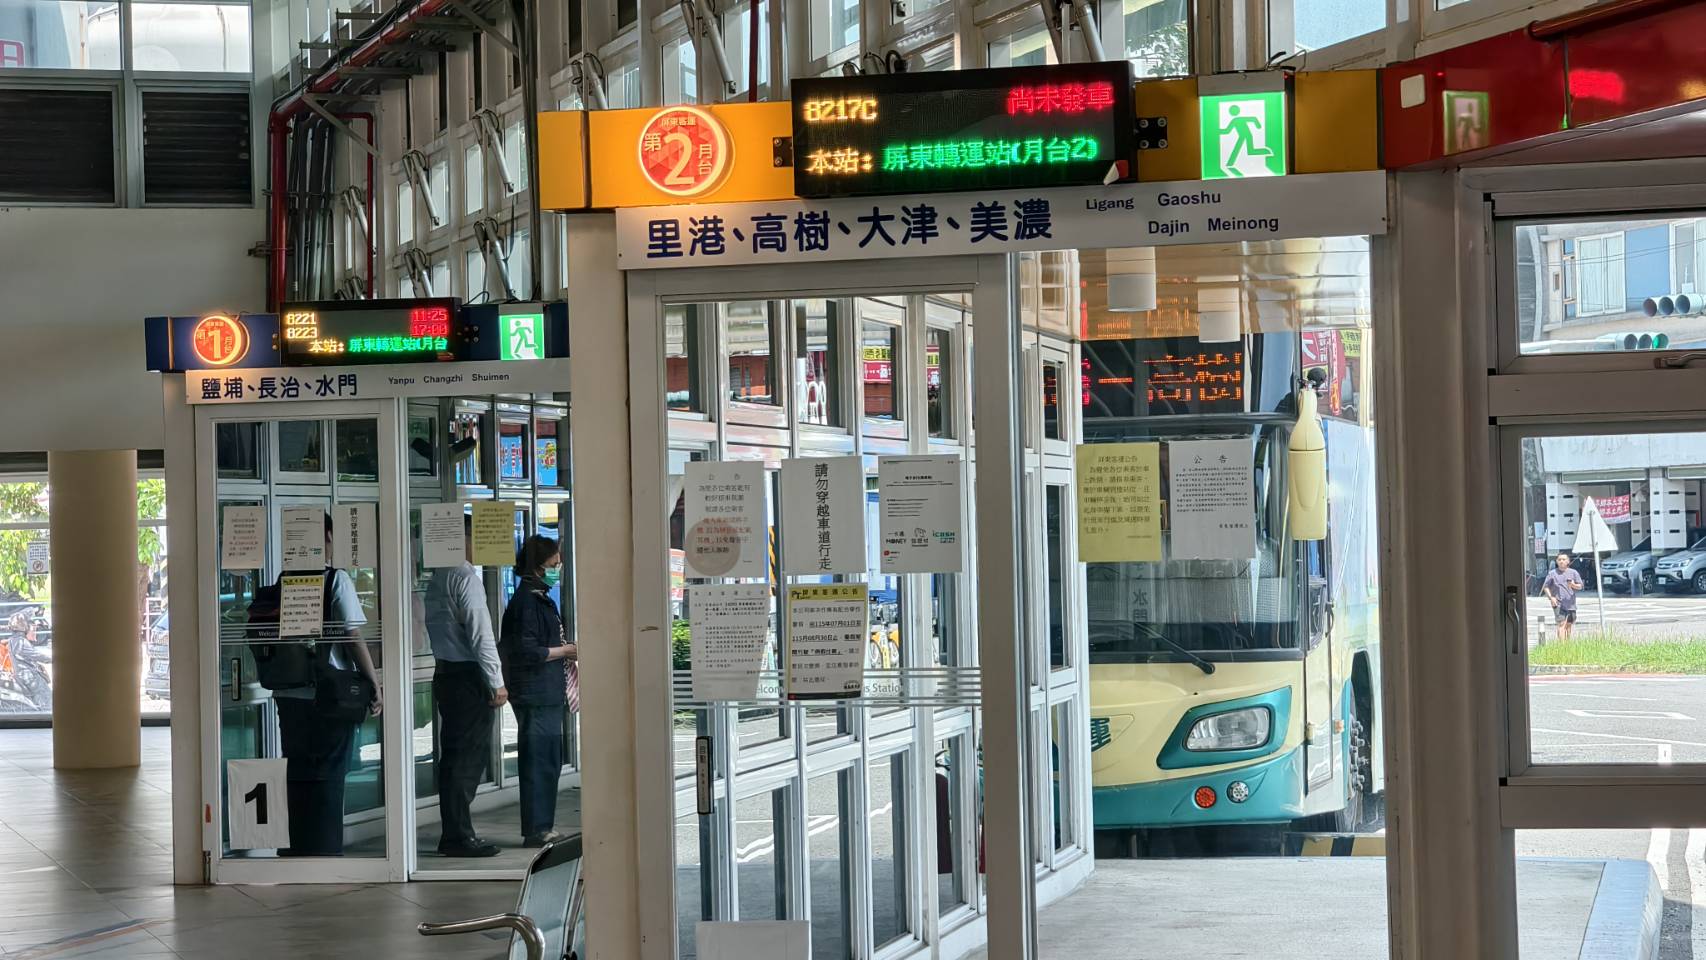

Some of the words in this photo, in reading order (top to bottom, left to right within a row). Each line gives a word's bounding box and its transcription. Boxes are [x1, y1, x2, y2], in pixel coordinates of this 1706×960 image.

[804, 99, 878, 121] 8217C
[1008, 83, 1114, 114] 尚未發車
[664, 132, 695, 186] 2
[1086, 197, 1134, 212] Ligang
[1157, 191, 1221, 207] Gaoshu
[647, 199, 1053, 260] 里港、高樹、大津、美濃
[1148, 218, 1190, 237] Dajin
[1207, 216, 1279, 232] Meinong
[287, 313, 316, 325] 8221
[412, 309, 448, 322] 11:25
[287, 327, 318, 339] 8223
[201, 373, 358, 400] 鹽埔、長治、水門
[388, 376, 415, 386] Yanpu
[423, 374, 463, 385] Changzhi
[472, 373, 510, 382] Shuimen
[814, 462, 833, 570] 請勿穿越車道行走
[245, 783, 268, 824] 1
